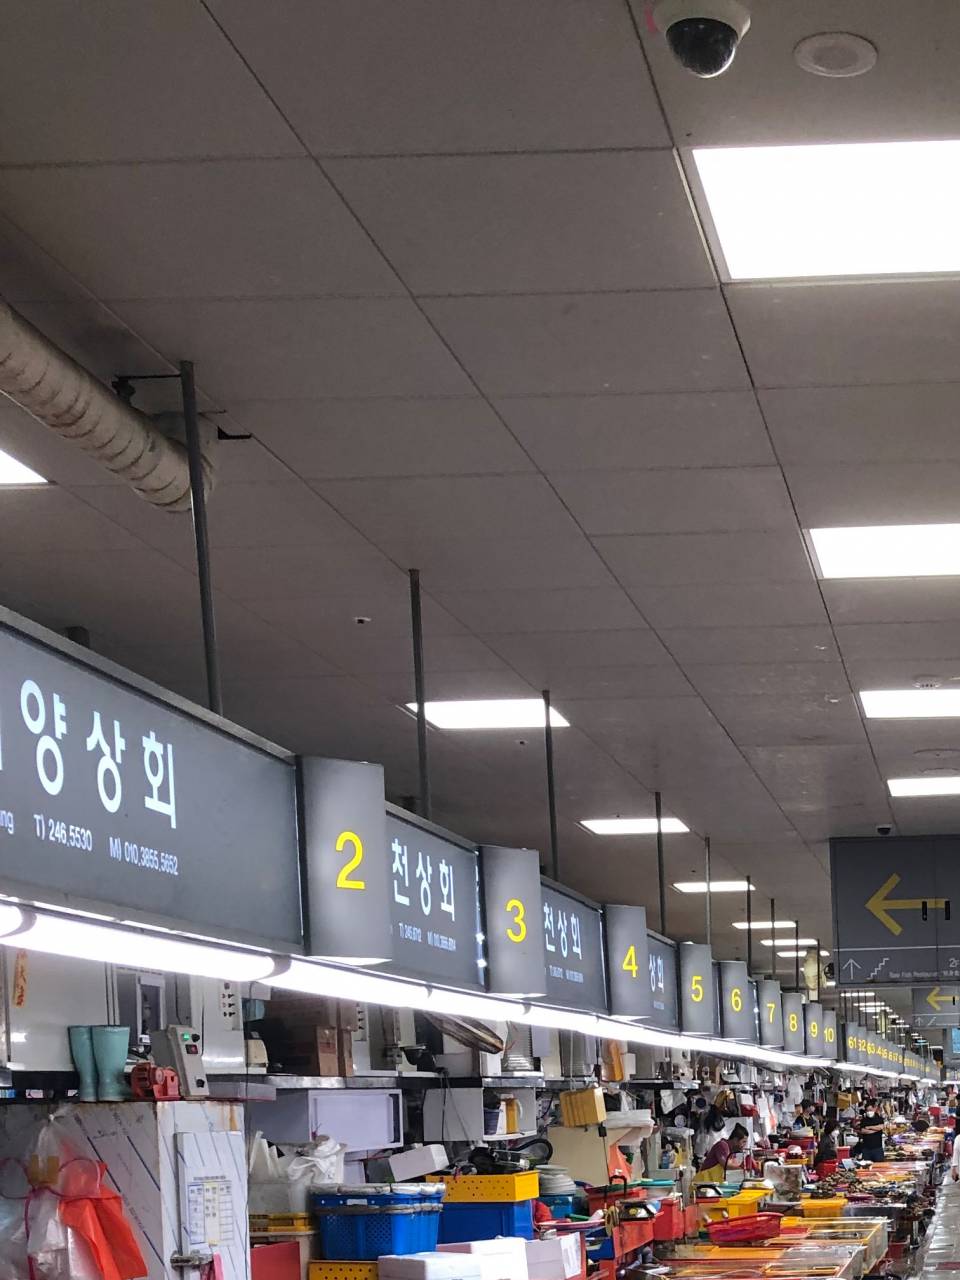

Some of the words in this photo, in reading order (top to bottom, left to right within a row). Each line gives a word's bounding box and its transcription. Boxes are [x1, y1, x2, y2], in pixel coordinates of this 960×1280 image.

[335, 831, 366, 890] 2
[505, 898, 527, 943] 3
[622, 945, 639, 978] 4
[691, 975, 703, 1002] 5
[731, 988, 743, 1012] 6
[767, 1003, 776, 1024] 7
[789, 1014, 798, 1032] 8
[809, 1022, 818, 1037] 9
[824, 1028, 834, 1042] 10
